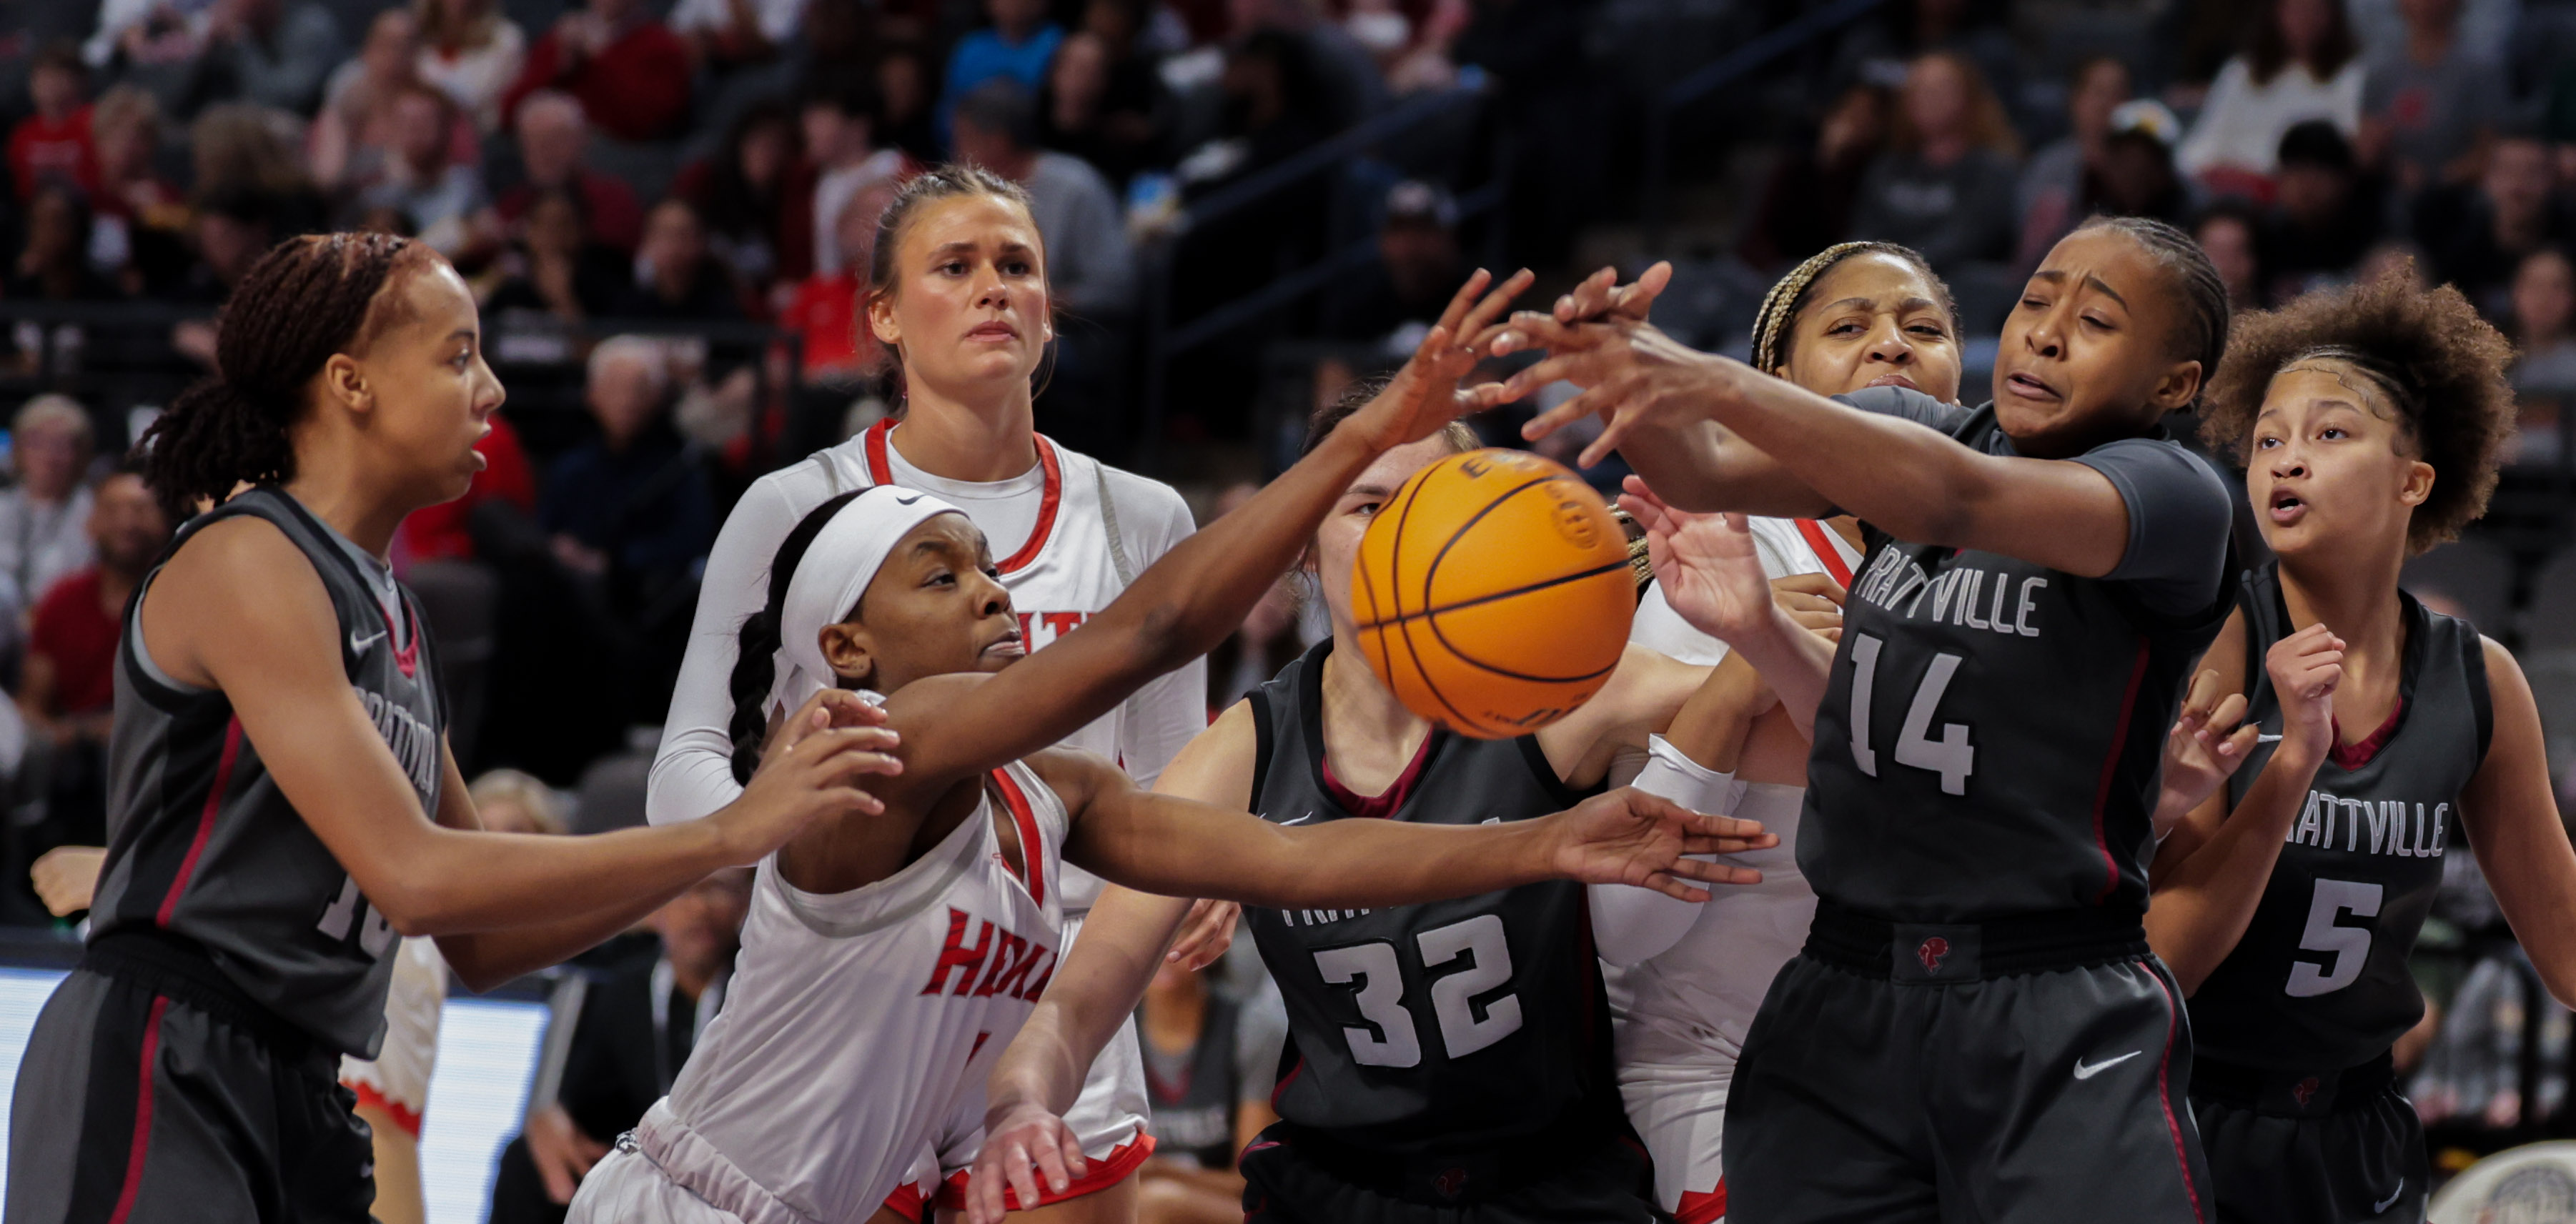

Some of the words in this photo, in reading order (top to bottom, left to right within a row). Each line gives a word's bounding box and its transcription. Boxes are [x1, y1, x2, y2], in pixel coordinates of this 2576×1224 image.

[1850, 632, 1973, 795] 14
[2286, 790, 2449, 857] ATTVILLE
[1313, 913, 1523, 1068] 32
[2285, 878, 2383, 997] 5
